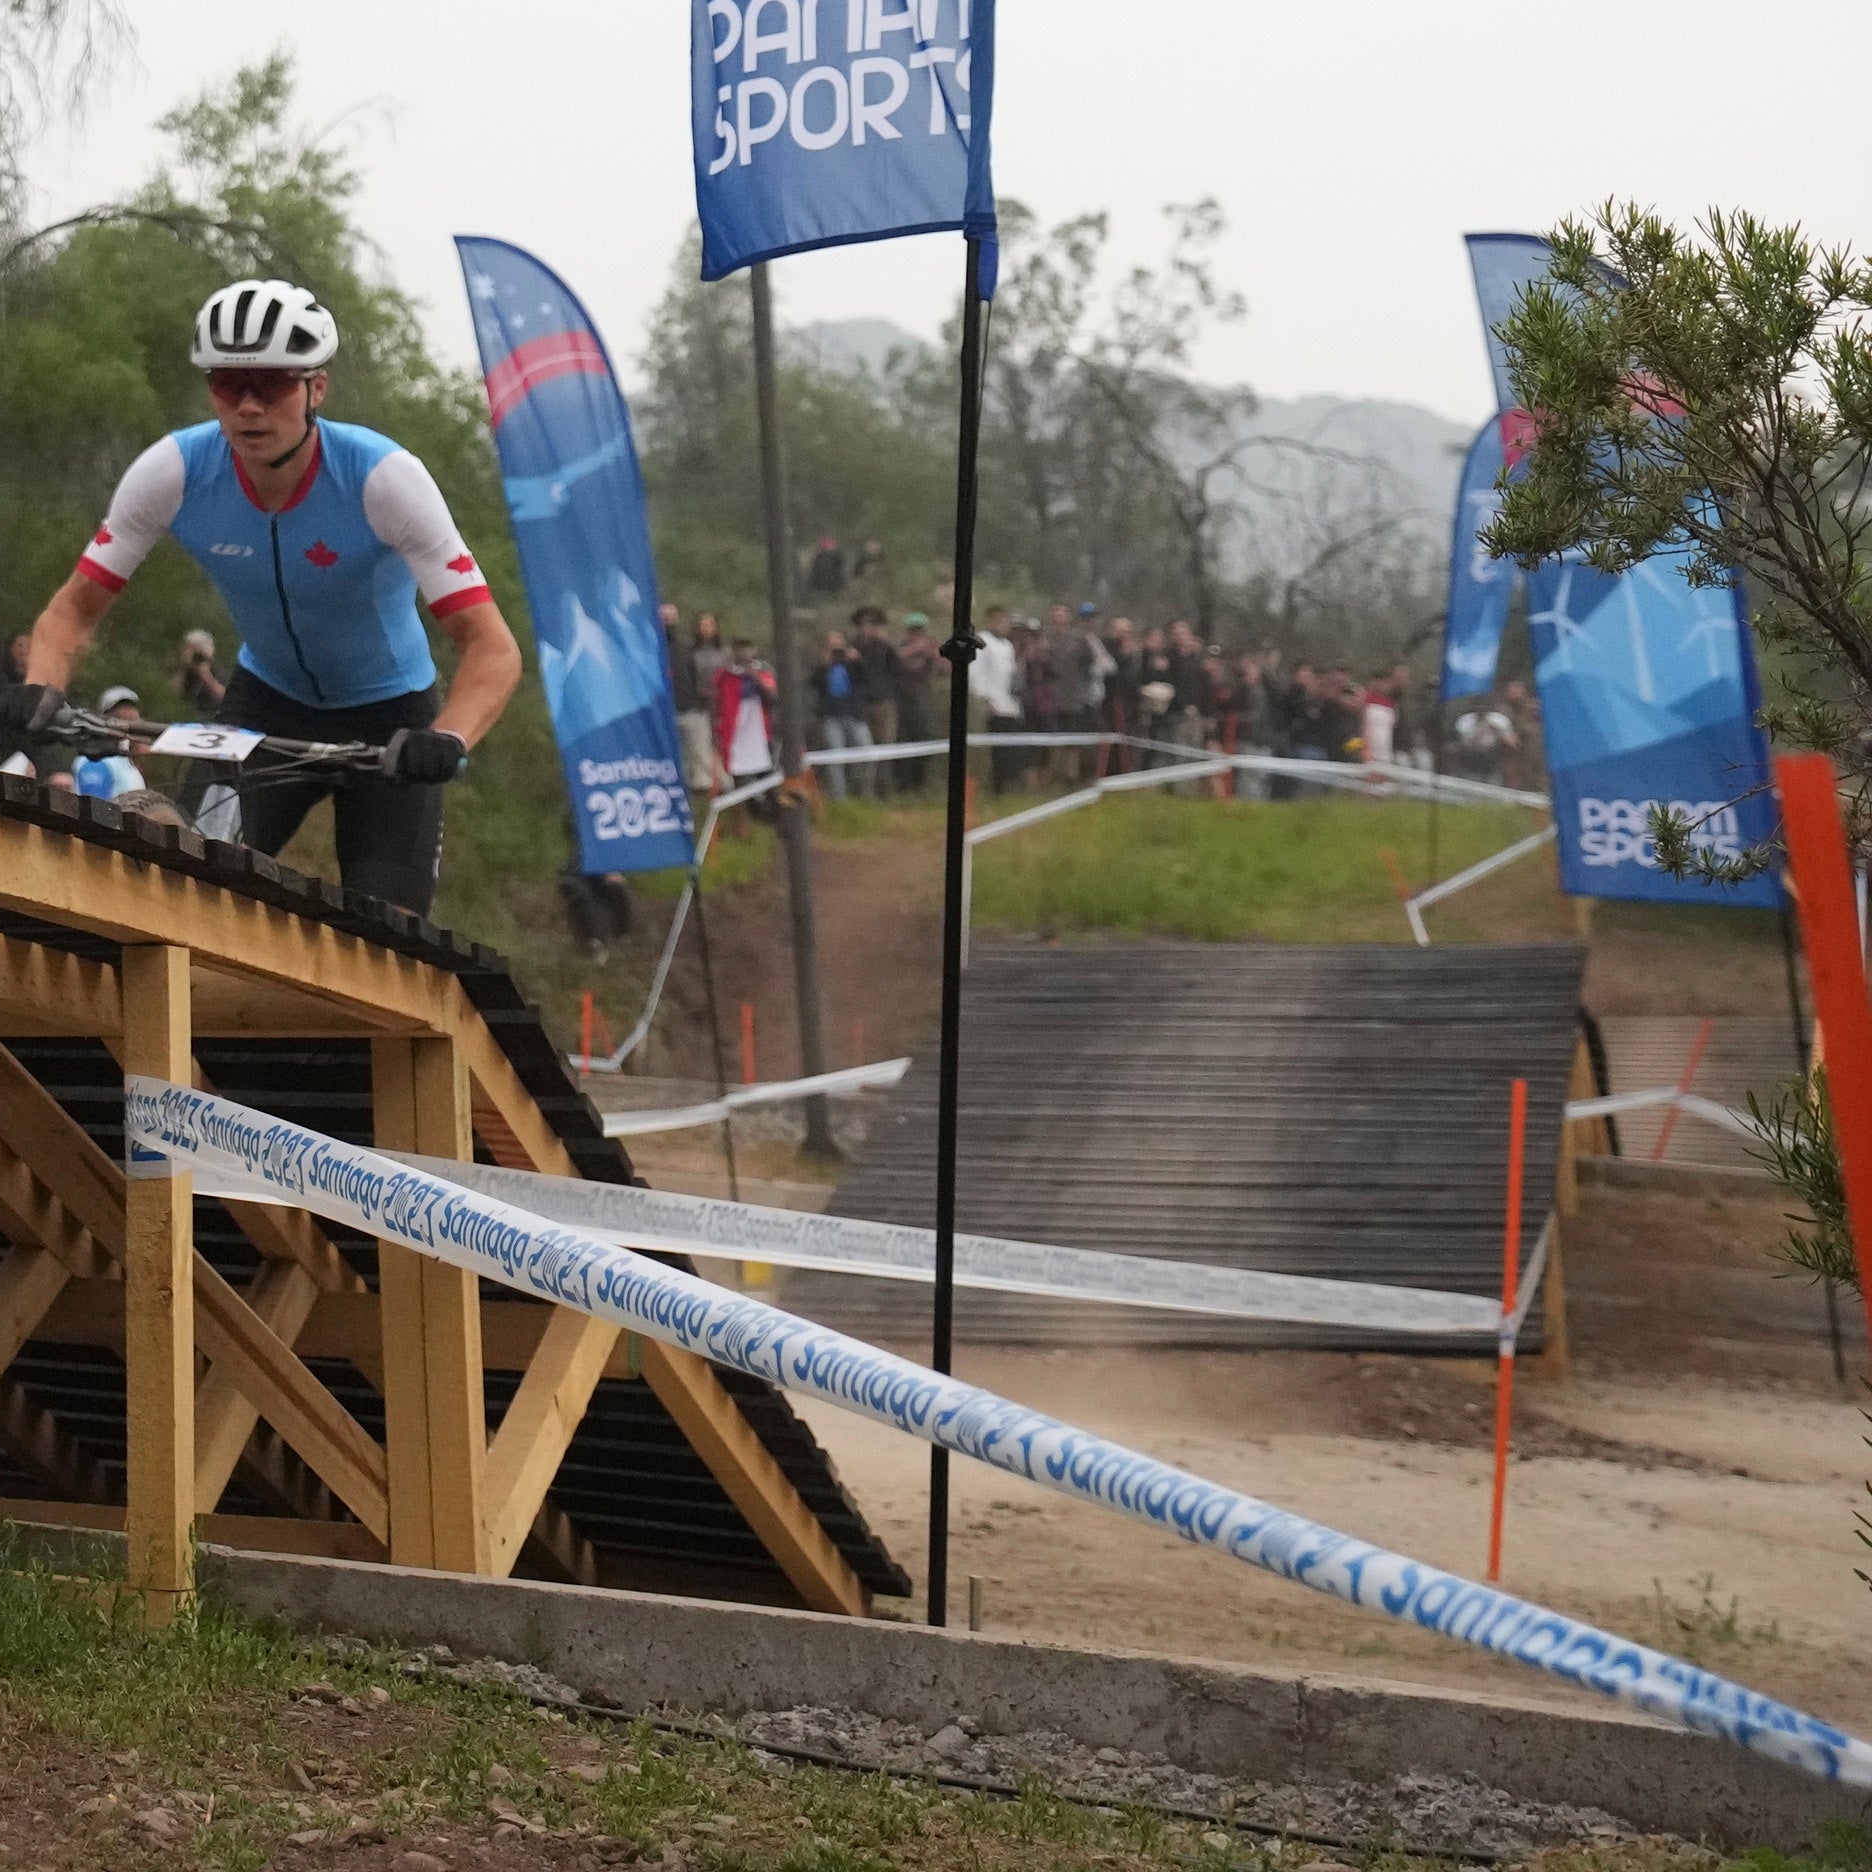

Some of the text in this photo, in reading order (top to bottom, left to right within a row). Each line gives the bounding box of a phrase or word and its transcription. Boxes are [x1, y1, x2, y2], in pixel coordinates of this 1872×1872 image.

[188, 732, 227, 749] 3
[579, 756, 678, 786] Santiag
[200, 1102, 261, 1173] Santiago
[261, 1124, 316, 1195] 2023
[308, 1142, 385, 1220] Santiago
[382, 1171, 450, 1247] 2023
[439, 1194, 531, 1277] Santiago
[527, 1229, 610, 1310] 2023
[597, 1256, 713, 1347] Santiago
[706, 1300, 806, 1387] 2023
[793, 1334, 942, 1434] Santiago
[932, 1389, 1065, 1481] 2023
[1045, 1435, 1239, 1543] Santiago
